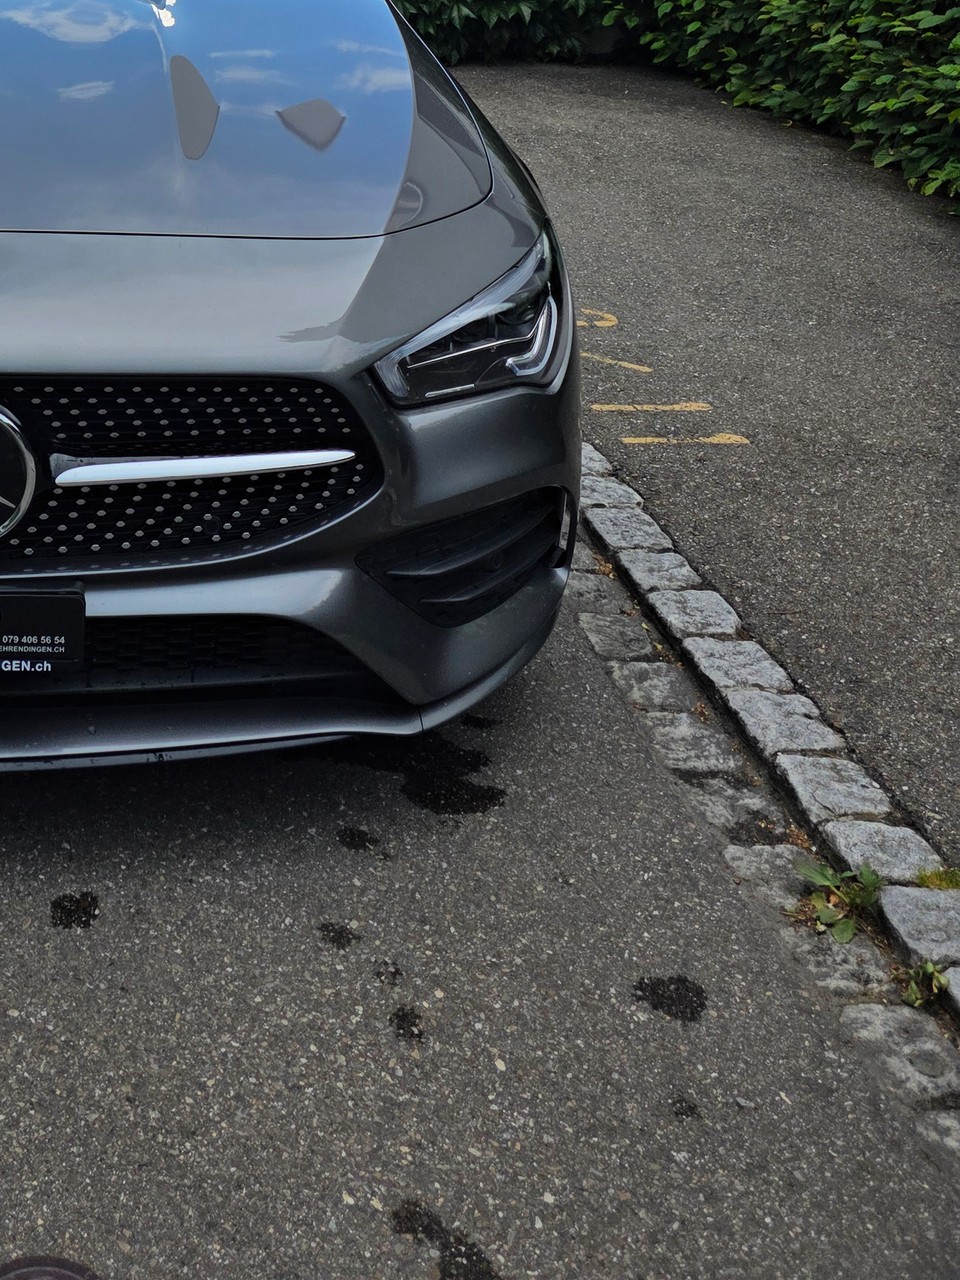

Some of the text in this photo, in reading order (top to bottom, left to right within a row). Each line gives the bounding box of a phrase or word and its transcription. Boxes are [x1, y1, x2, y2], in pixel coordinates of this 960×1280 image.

[2, 635, 65, 644] 079 406 56 54
